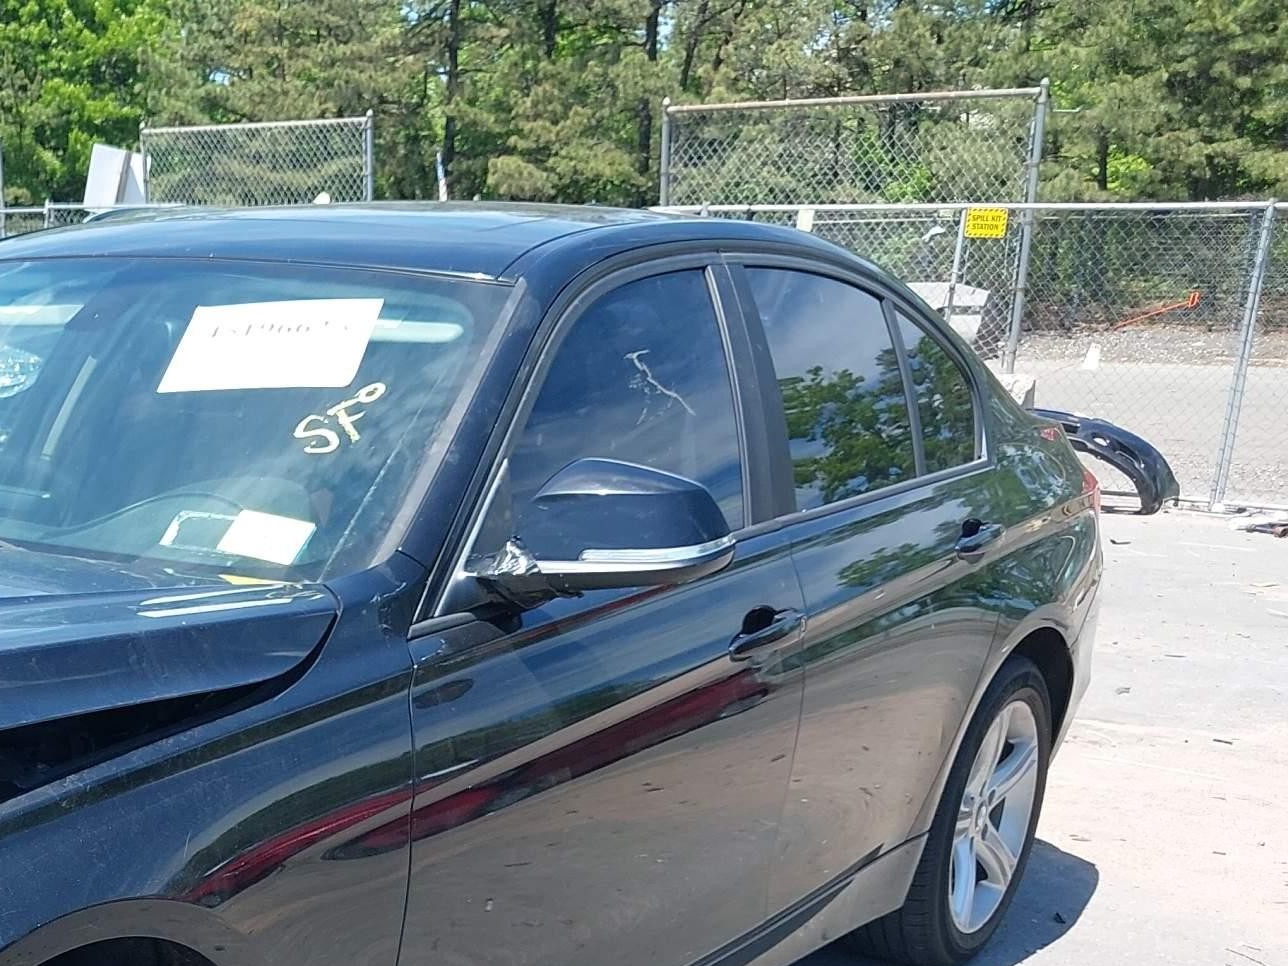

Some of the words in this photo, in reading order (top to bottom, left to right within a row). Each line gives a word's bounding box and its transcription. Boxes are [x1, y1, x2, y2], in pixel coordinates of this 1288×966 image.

[972, 214, 989, 222] SPILL
[992, 215, 1003, 223] KIT
[972, 223, 999, 231] STATION
